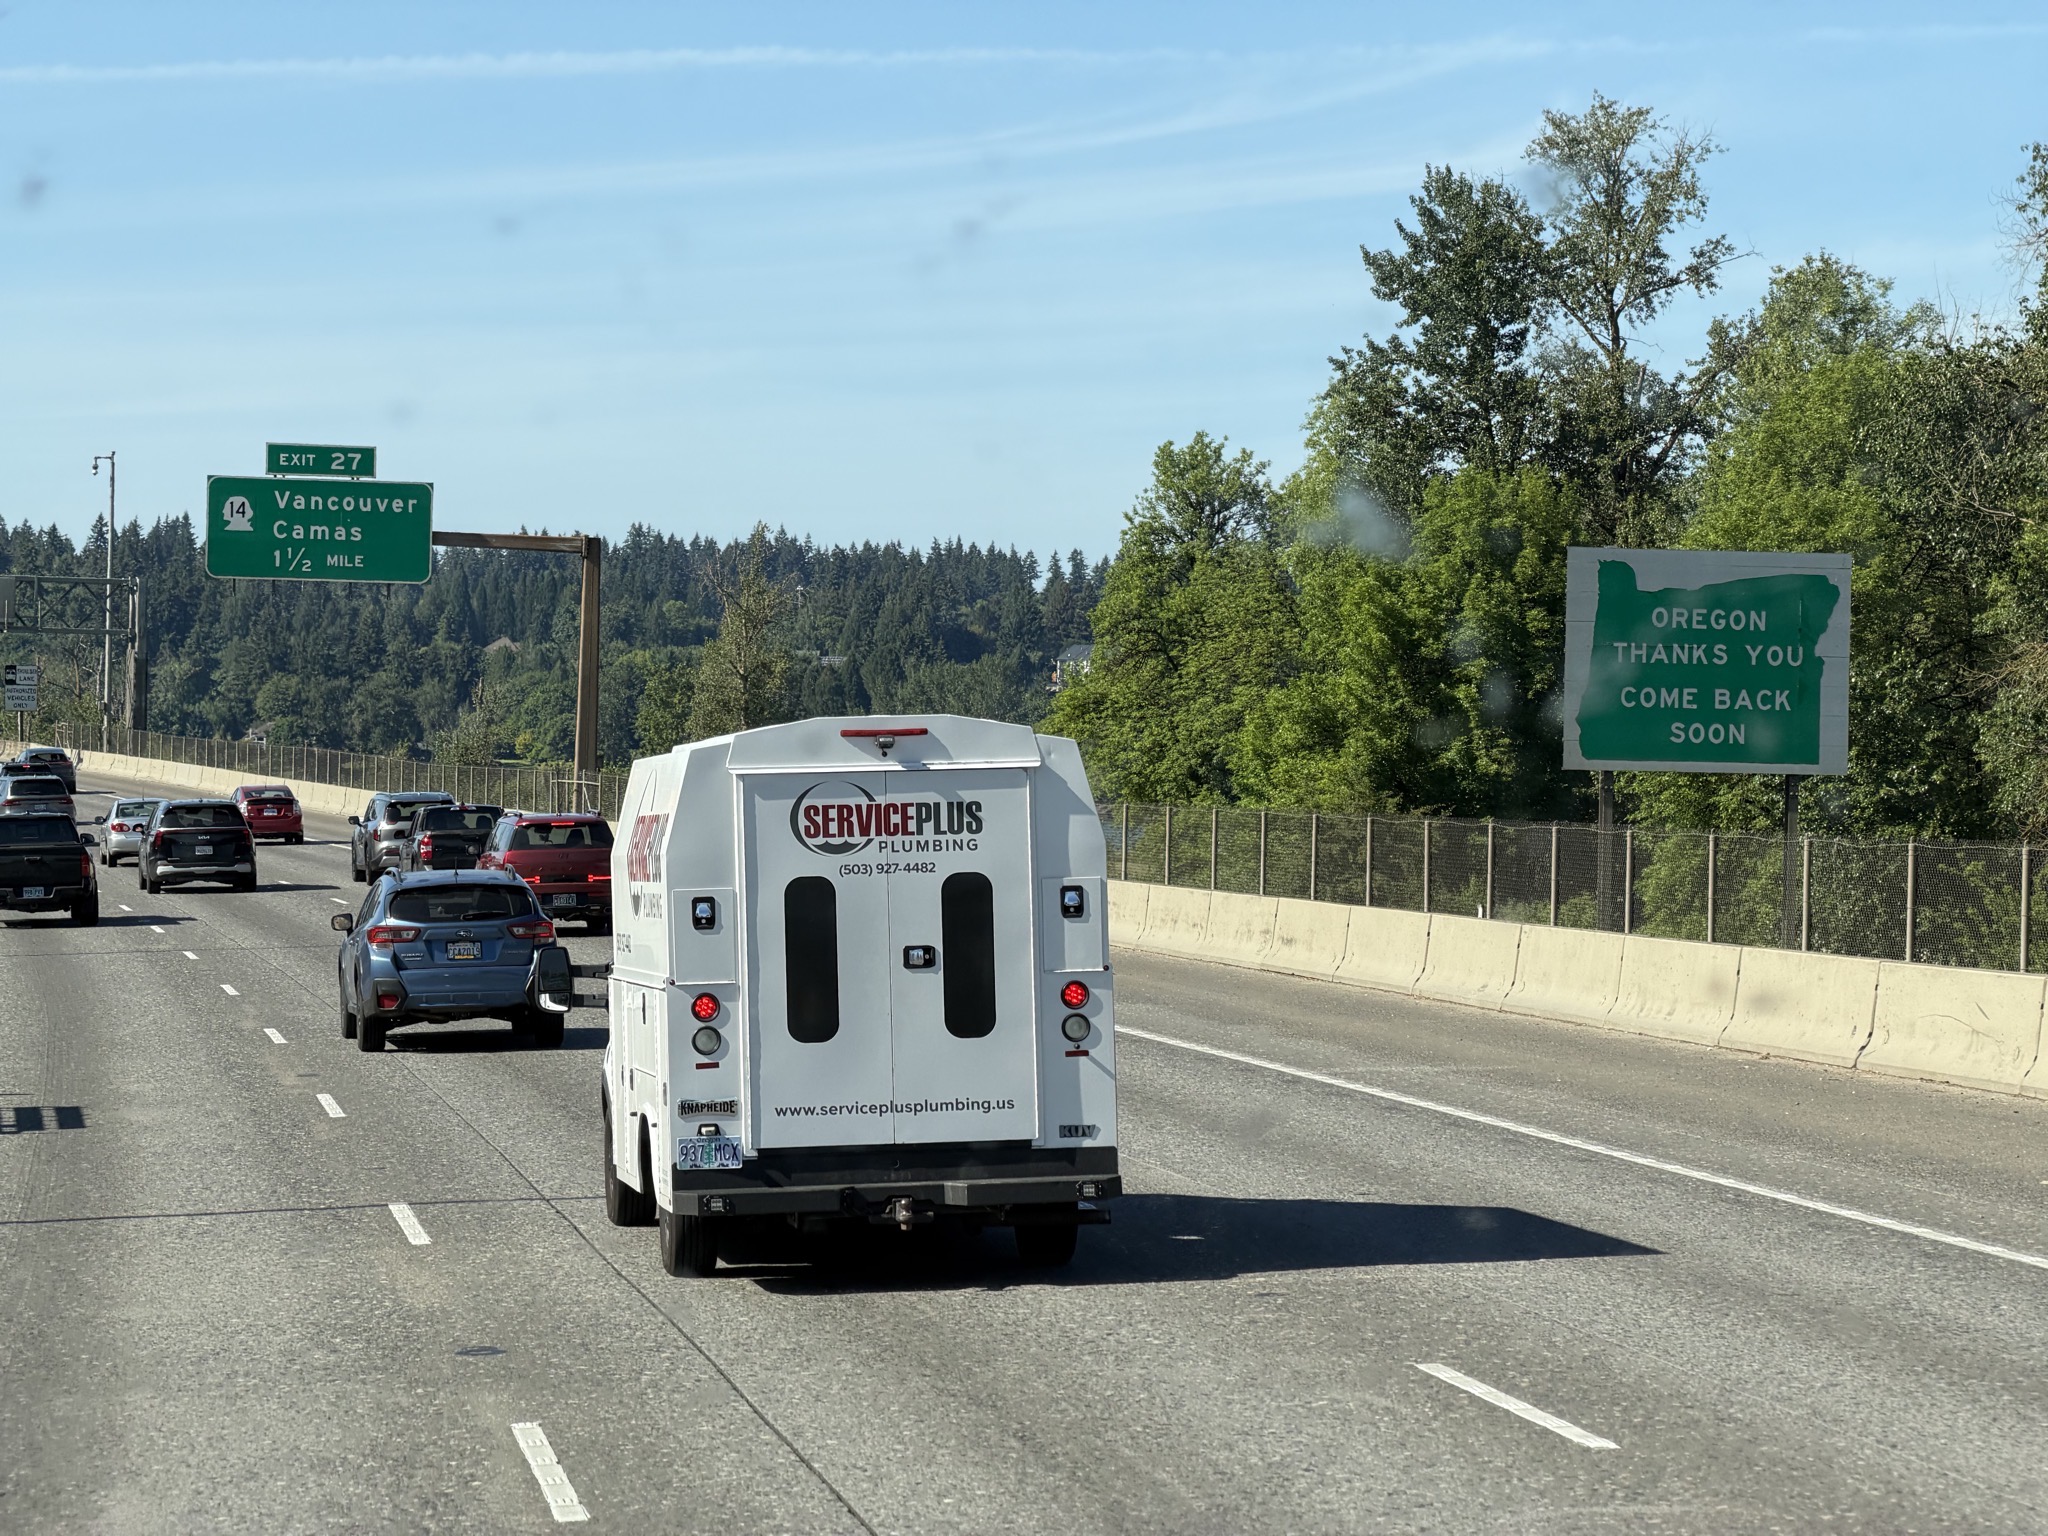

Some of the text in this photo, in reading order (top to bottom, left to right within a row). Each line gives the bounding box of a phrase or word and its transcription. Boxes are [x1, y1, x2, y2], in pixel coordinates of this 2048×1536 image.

[279, 453, 362, 470] EXIT 27
[229, 500, 246, 518] 14
[274, 490, 418, 513] Vancouver
[273, 520, 362, 541] Camas
[326, 554, 364, 567] MILE
[1651, 607, 1767, 632] OREGON
[1613, 642, 1804, 667] THANKS YOU
[1620, 686, 1792, 712] COME BACK
[1669, 722, 1746, 745] SOON
[803, 801, 984, 839] SERVICEPLUS
[878, 839, 979, 854] PLUMBING
[838, 861, 937, 877] (503) 927-4482
[680, 1100, 736, 1116] KNAPHEIDE
[774, 1096, 1016, 1118] www.serviceplusplumbing.us
[1059, 1124, 1096, 1138] KUV
[680, 1143, 739, 1162] 937 MCX
